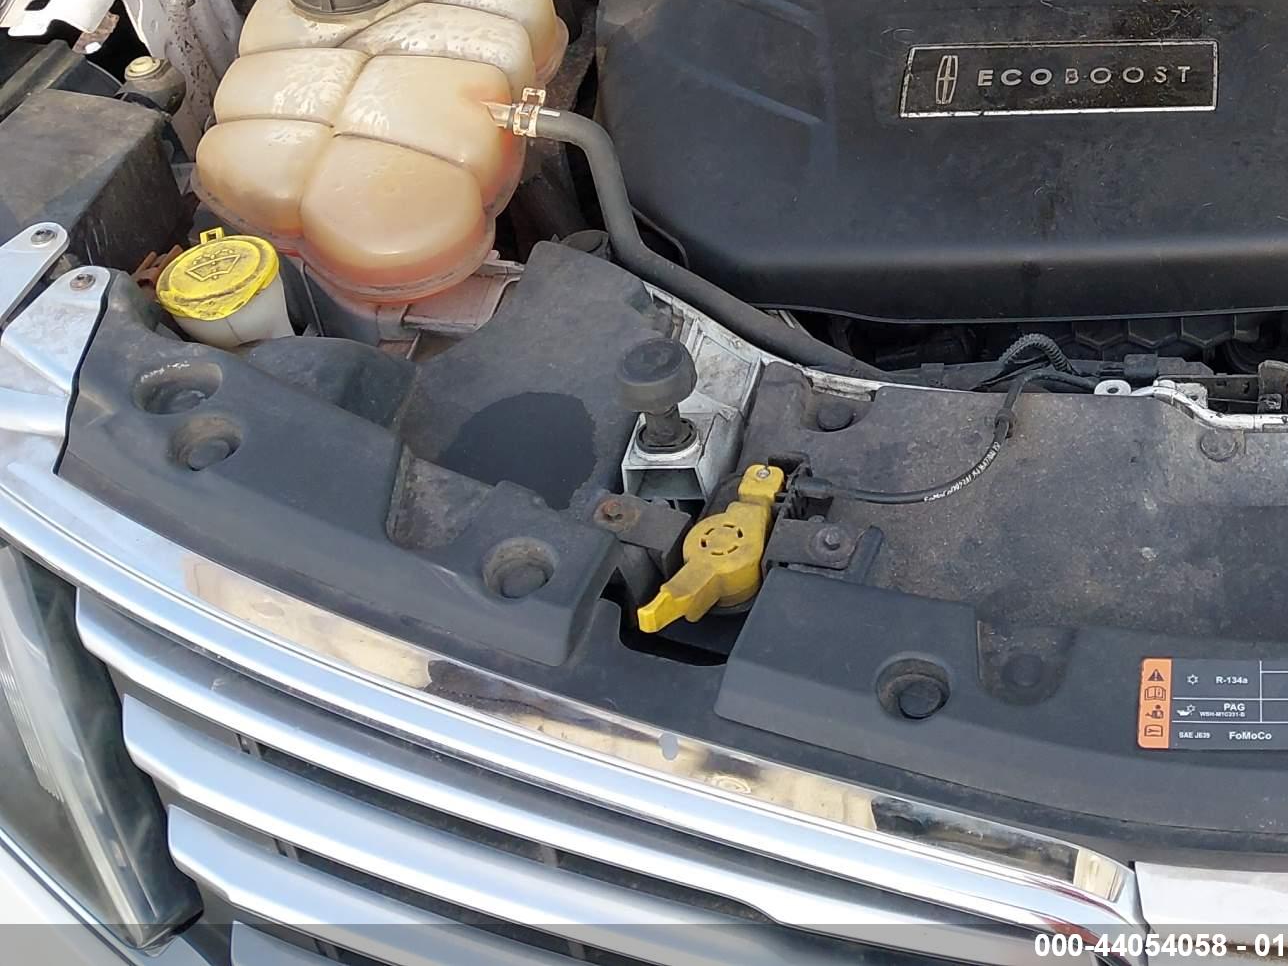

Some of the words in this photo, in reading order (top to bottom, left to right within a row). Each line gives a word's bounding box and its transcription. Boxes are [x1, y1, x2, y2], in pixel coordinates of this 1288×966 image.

[977, 66, 1191, 86] ECOBOOST
[1215, 675, 1248, 684] R-134a
[1223, 702, 1246, 712] PAG
[1178, 731, 1194, 739] SAE
[1228, 731, 1272, 740] FoMoCo
